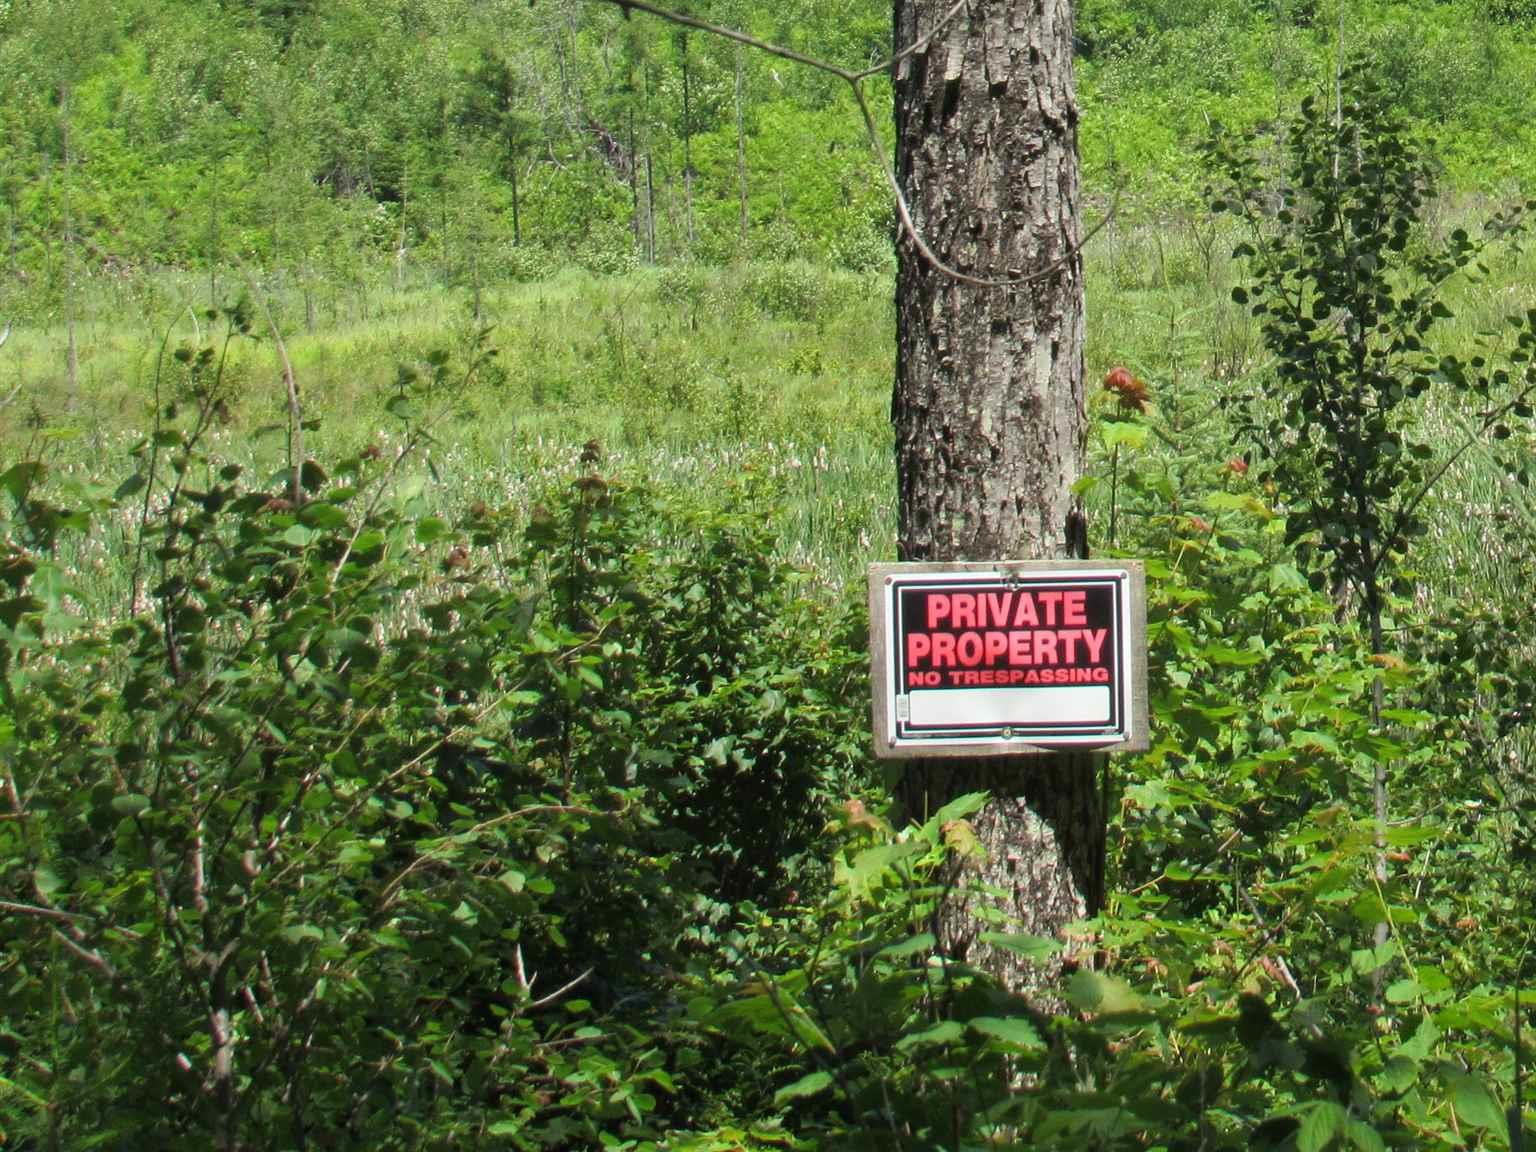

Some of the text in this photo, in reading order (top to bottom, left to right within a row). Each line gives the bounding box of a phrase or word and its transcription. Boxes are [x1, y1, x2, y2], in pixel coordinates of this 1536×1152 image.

[928, 592, 1087, 628] PRIVATE
[908, 629, 1108, 666] PROPERTY
[909, 668, 1108, 686] NO TRESPASSING
